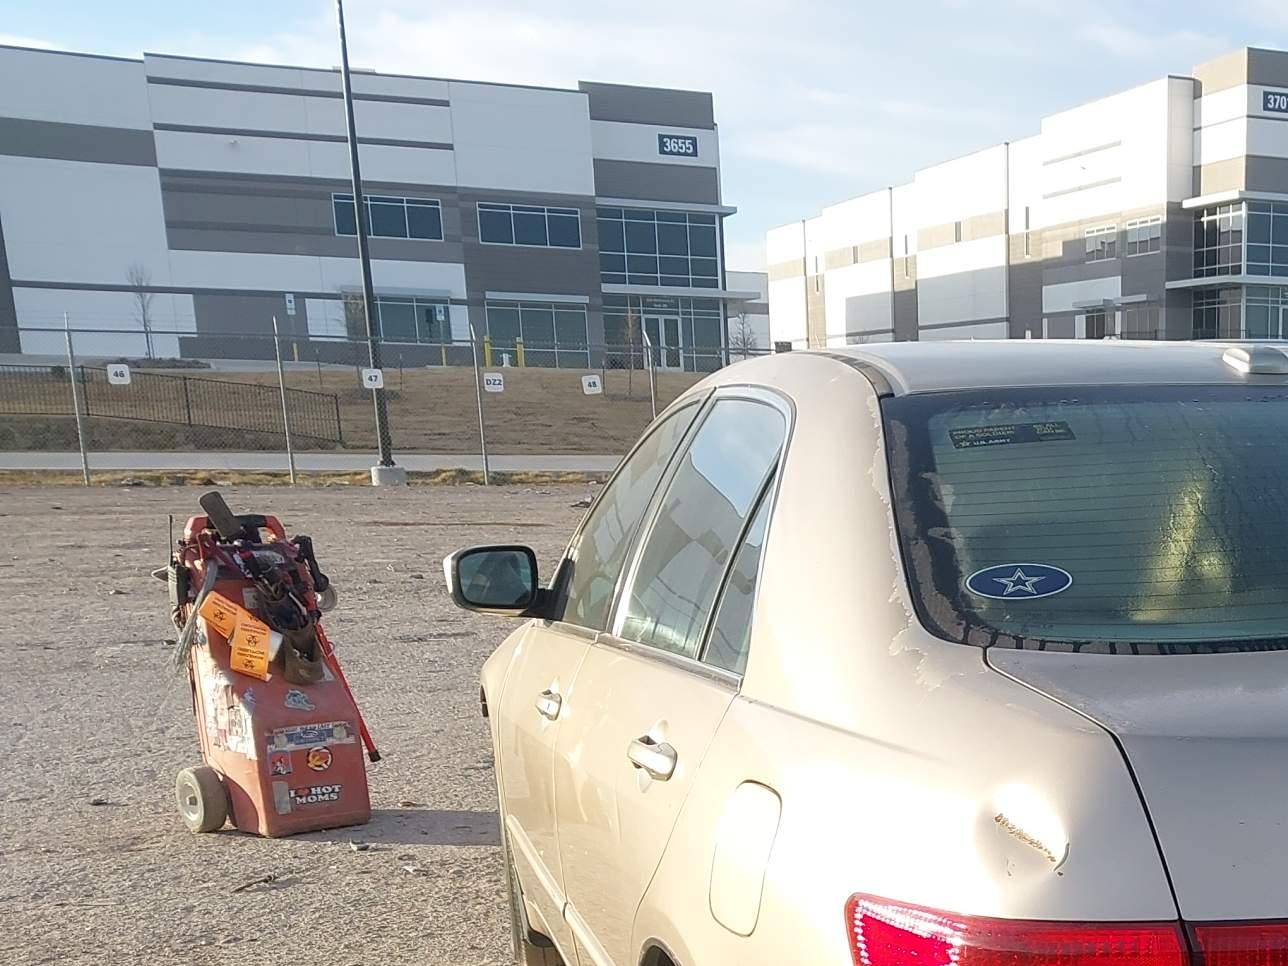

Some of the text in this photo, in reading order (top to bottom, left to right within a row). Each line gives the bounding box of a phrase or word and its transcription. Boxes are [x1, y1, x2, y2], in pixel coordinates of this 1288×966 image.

[663, 137, 694, 153] 3655
[311, 784, 342, 795] HOT
[296, 792, 338, 805] MOMS
